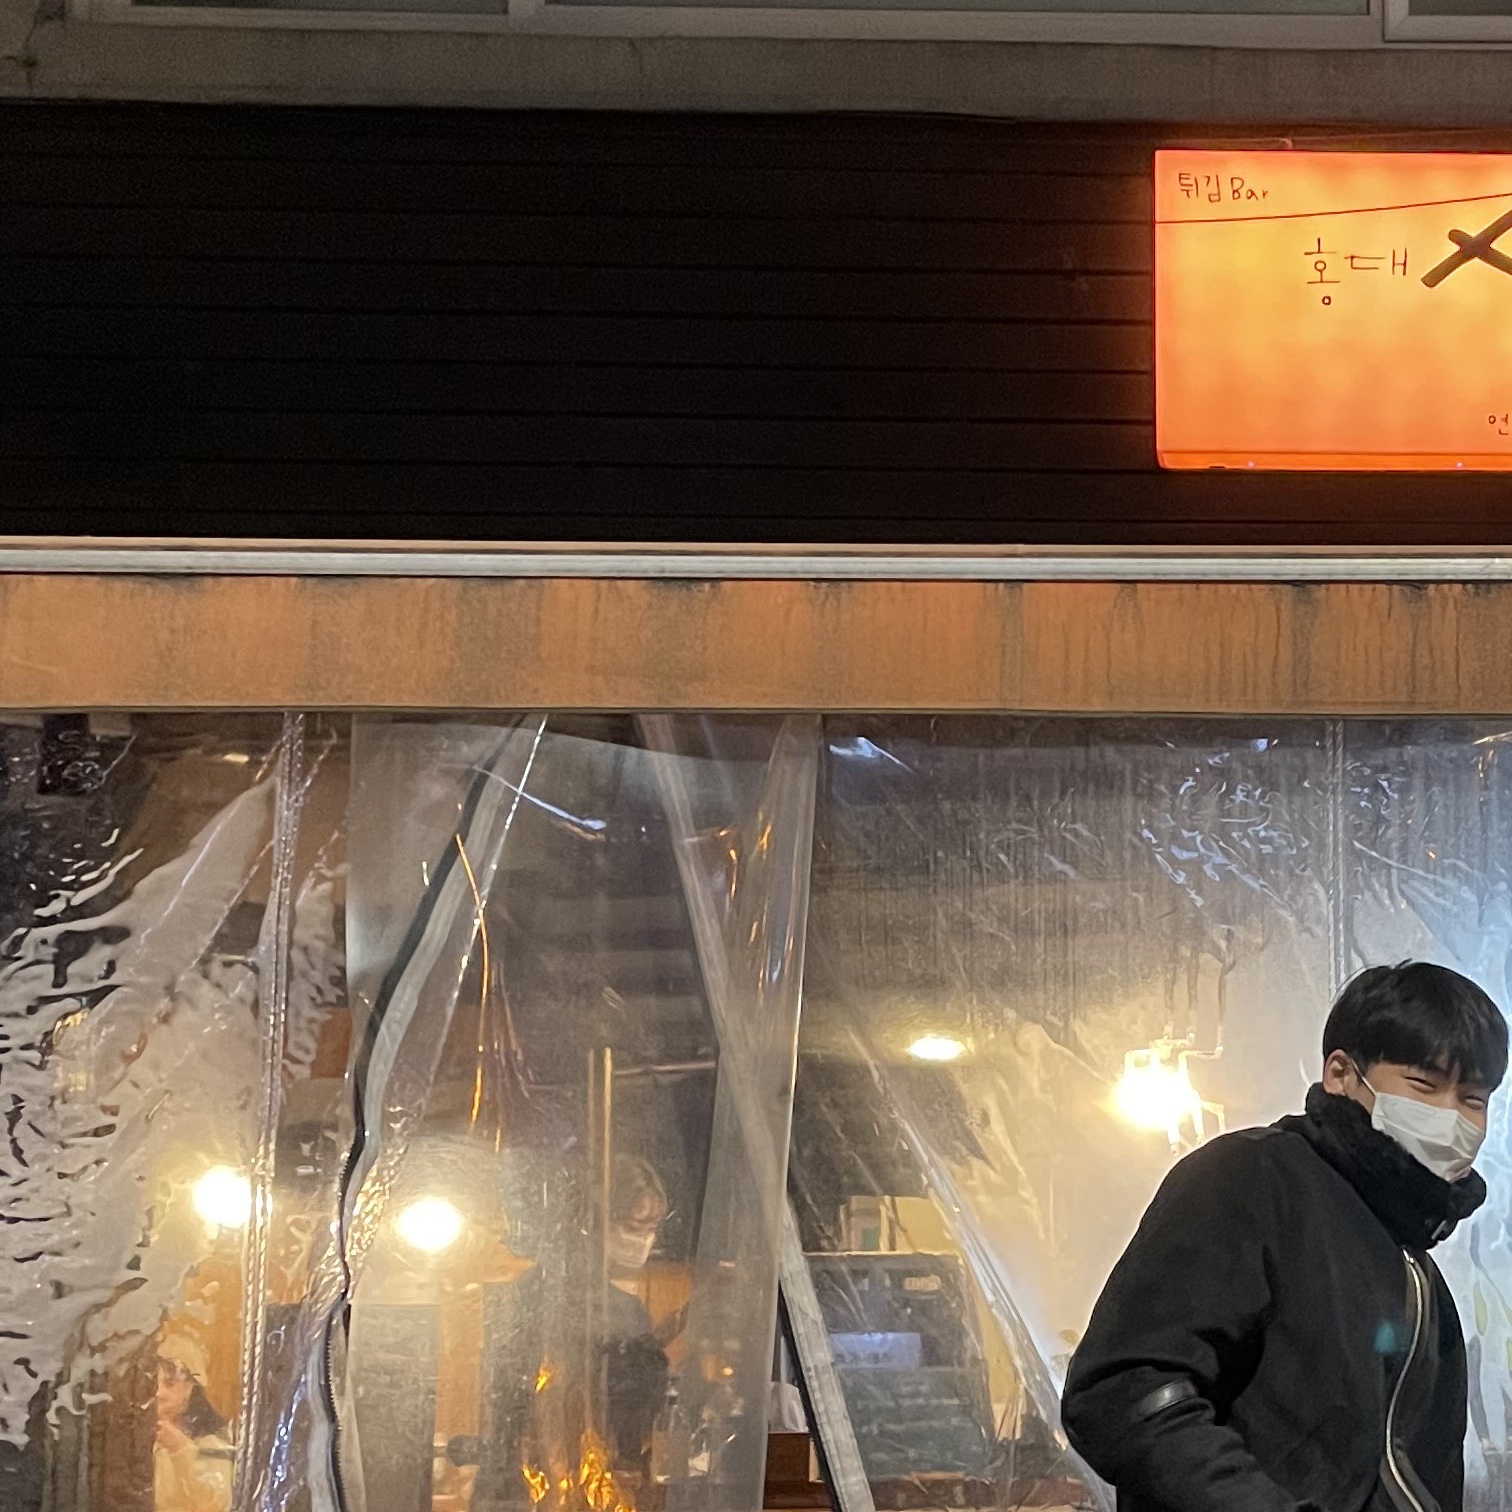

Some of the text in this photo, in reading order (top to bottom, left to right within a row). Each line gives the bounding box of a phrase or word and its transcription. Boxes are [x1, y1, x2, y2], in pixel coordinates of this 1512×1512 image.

[1178, 171, 1269, 203] 튀김 Bar
[1303, 237, 1408, 306] 홍대
